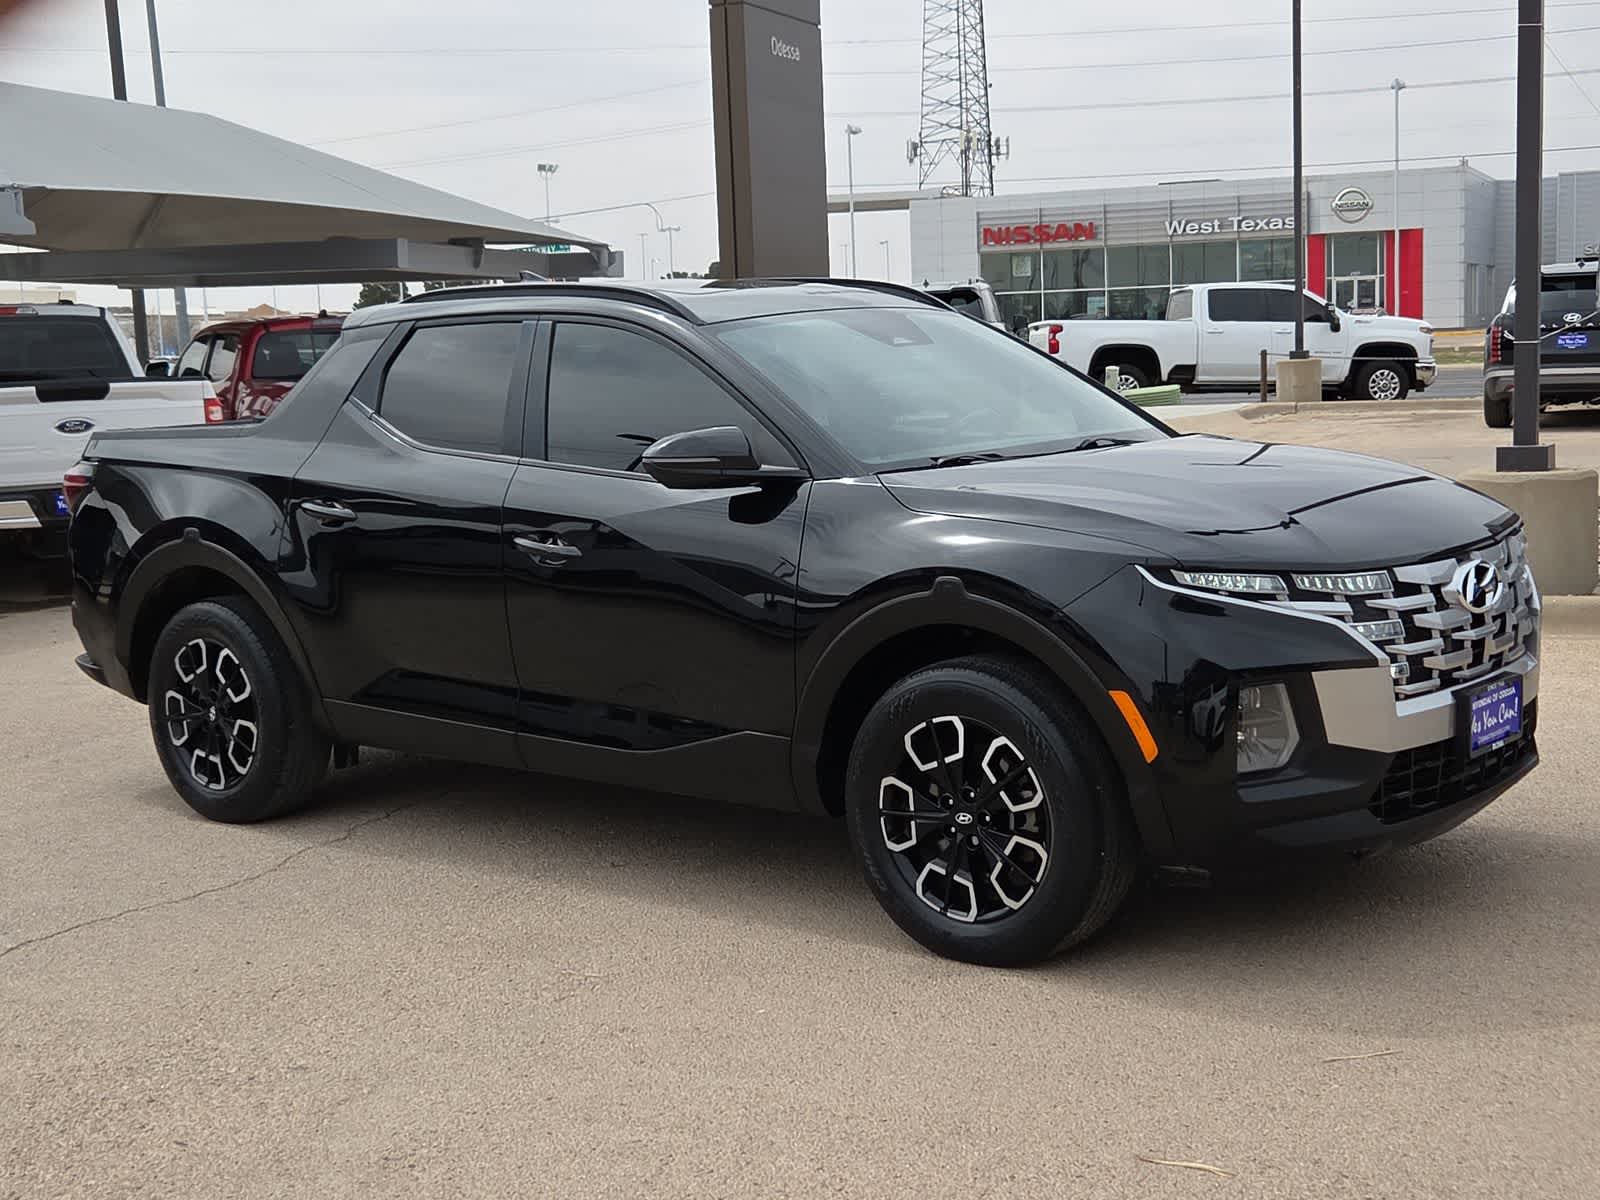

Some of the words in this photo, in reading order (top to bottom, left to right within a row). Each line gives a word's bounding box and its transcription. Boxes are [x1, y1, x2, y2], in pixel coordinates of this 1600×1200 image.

[771, 36, 800, 61] Odessa
[1334, 201, 1369, 210] NISSAN
[983, 222, 1096, 246] NISSAN
[1165, 218, 1221, 235] West
[1227, 215, 1295, 232] Texas
[63, 421, 87, 432] Ford
[1483, 709, 1498, 731] You
[1498, 696, 1519, 723] Can!
